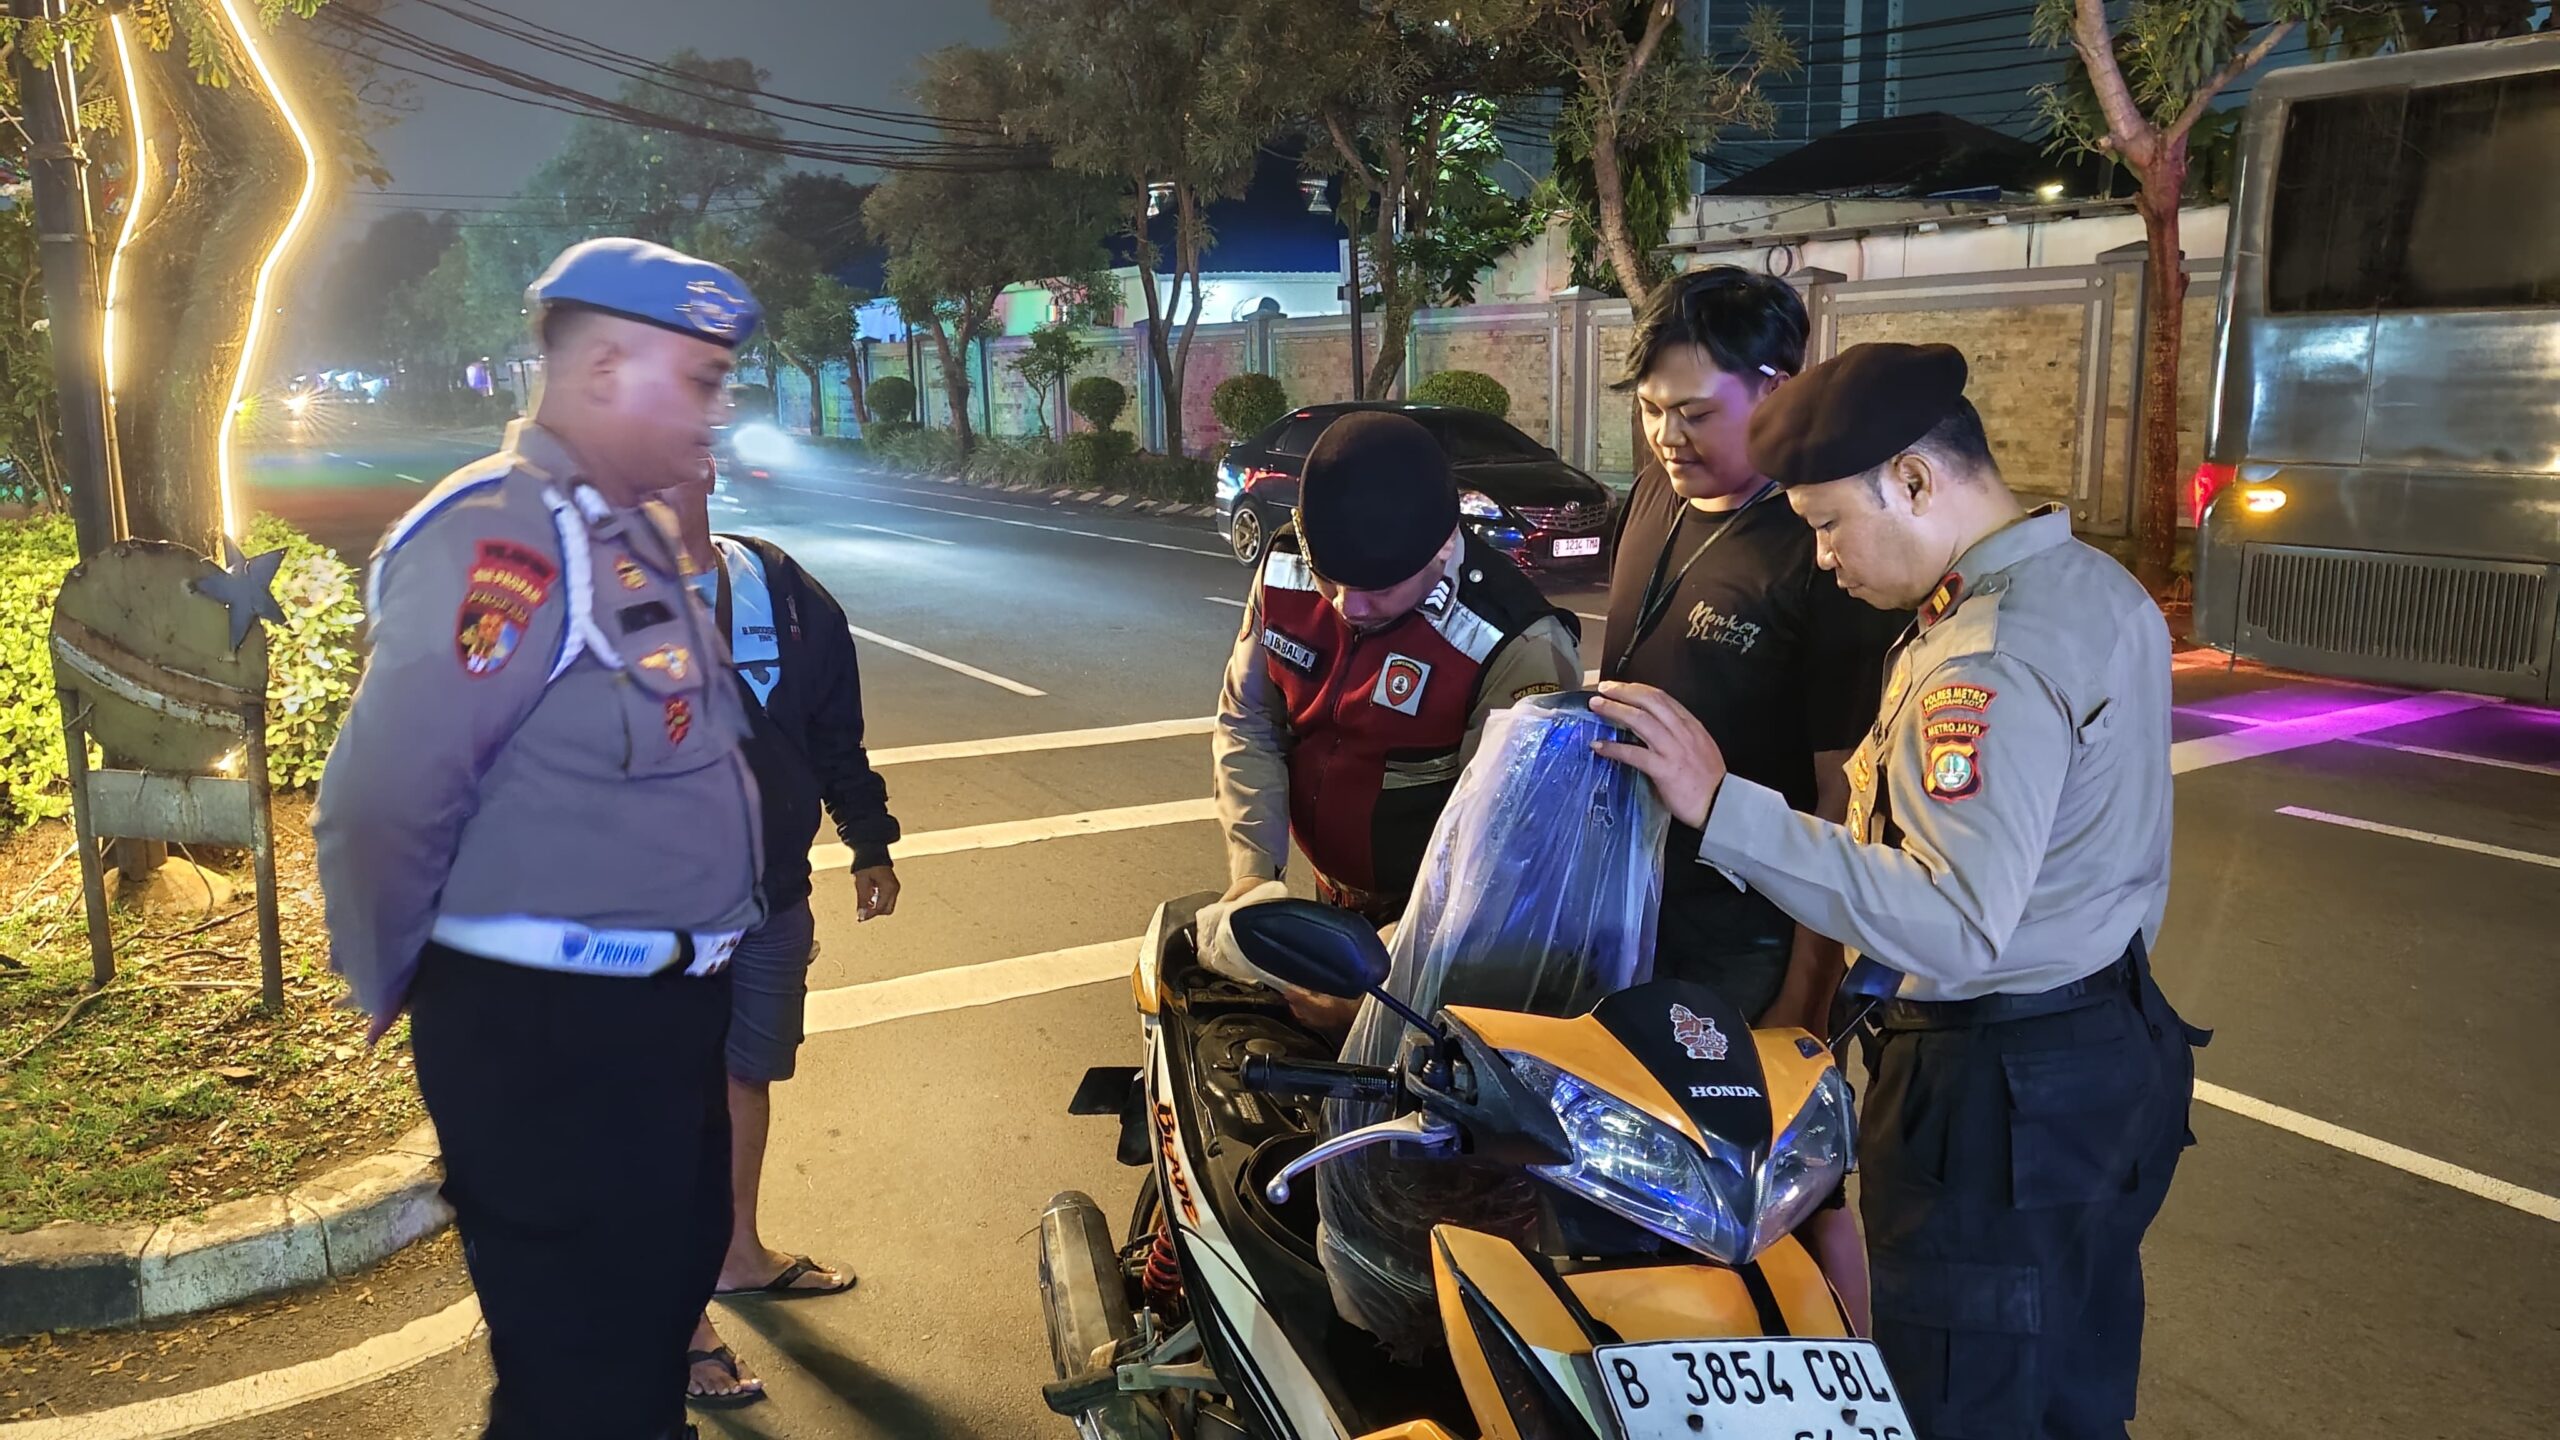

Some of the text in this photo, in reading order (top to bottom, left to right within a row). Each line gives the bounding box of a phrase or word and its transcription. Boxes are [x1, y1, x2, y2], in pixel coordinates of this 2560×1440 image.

[1923, 687, 1987, 707] POLRES METRO
[1927, 722, 1980, 736] METRO JAYA
[1689, 1086, 1762, 1098] HONDA
[1612, 1350, 1891, 1409] B 3854 CBL
